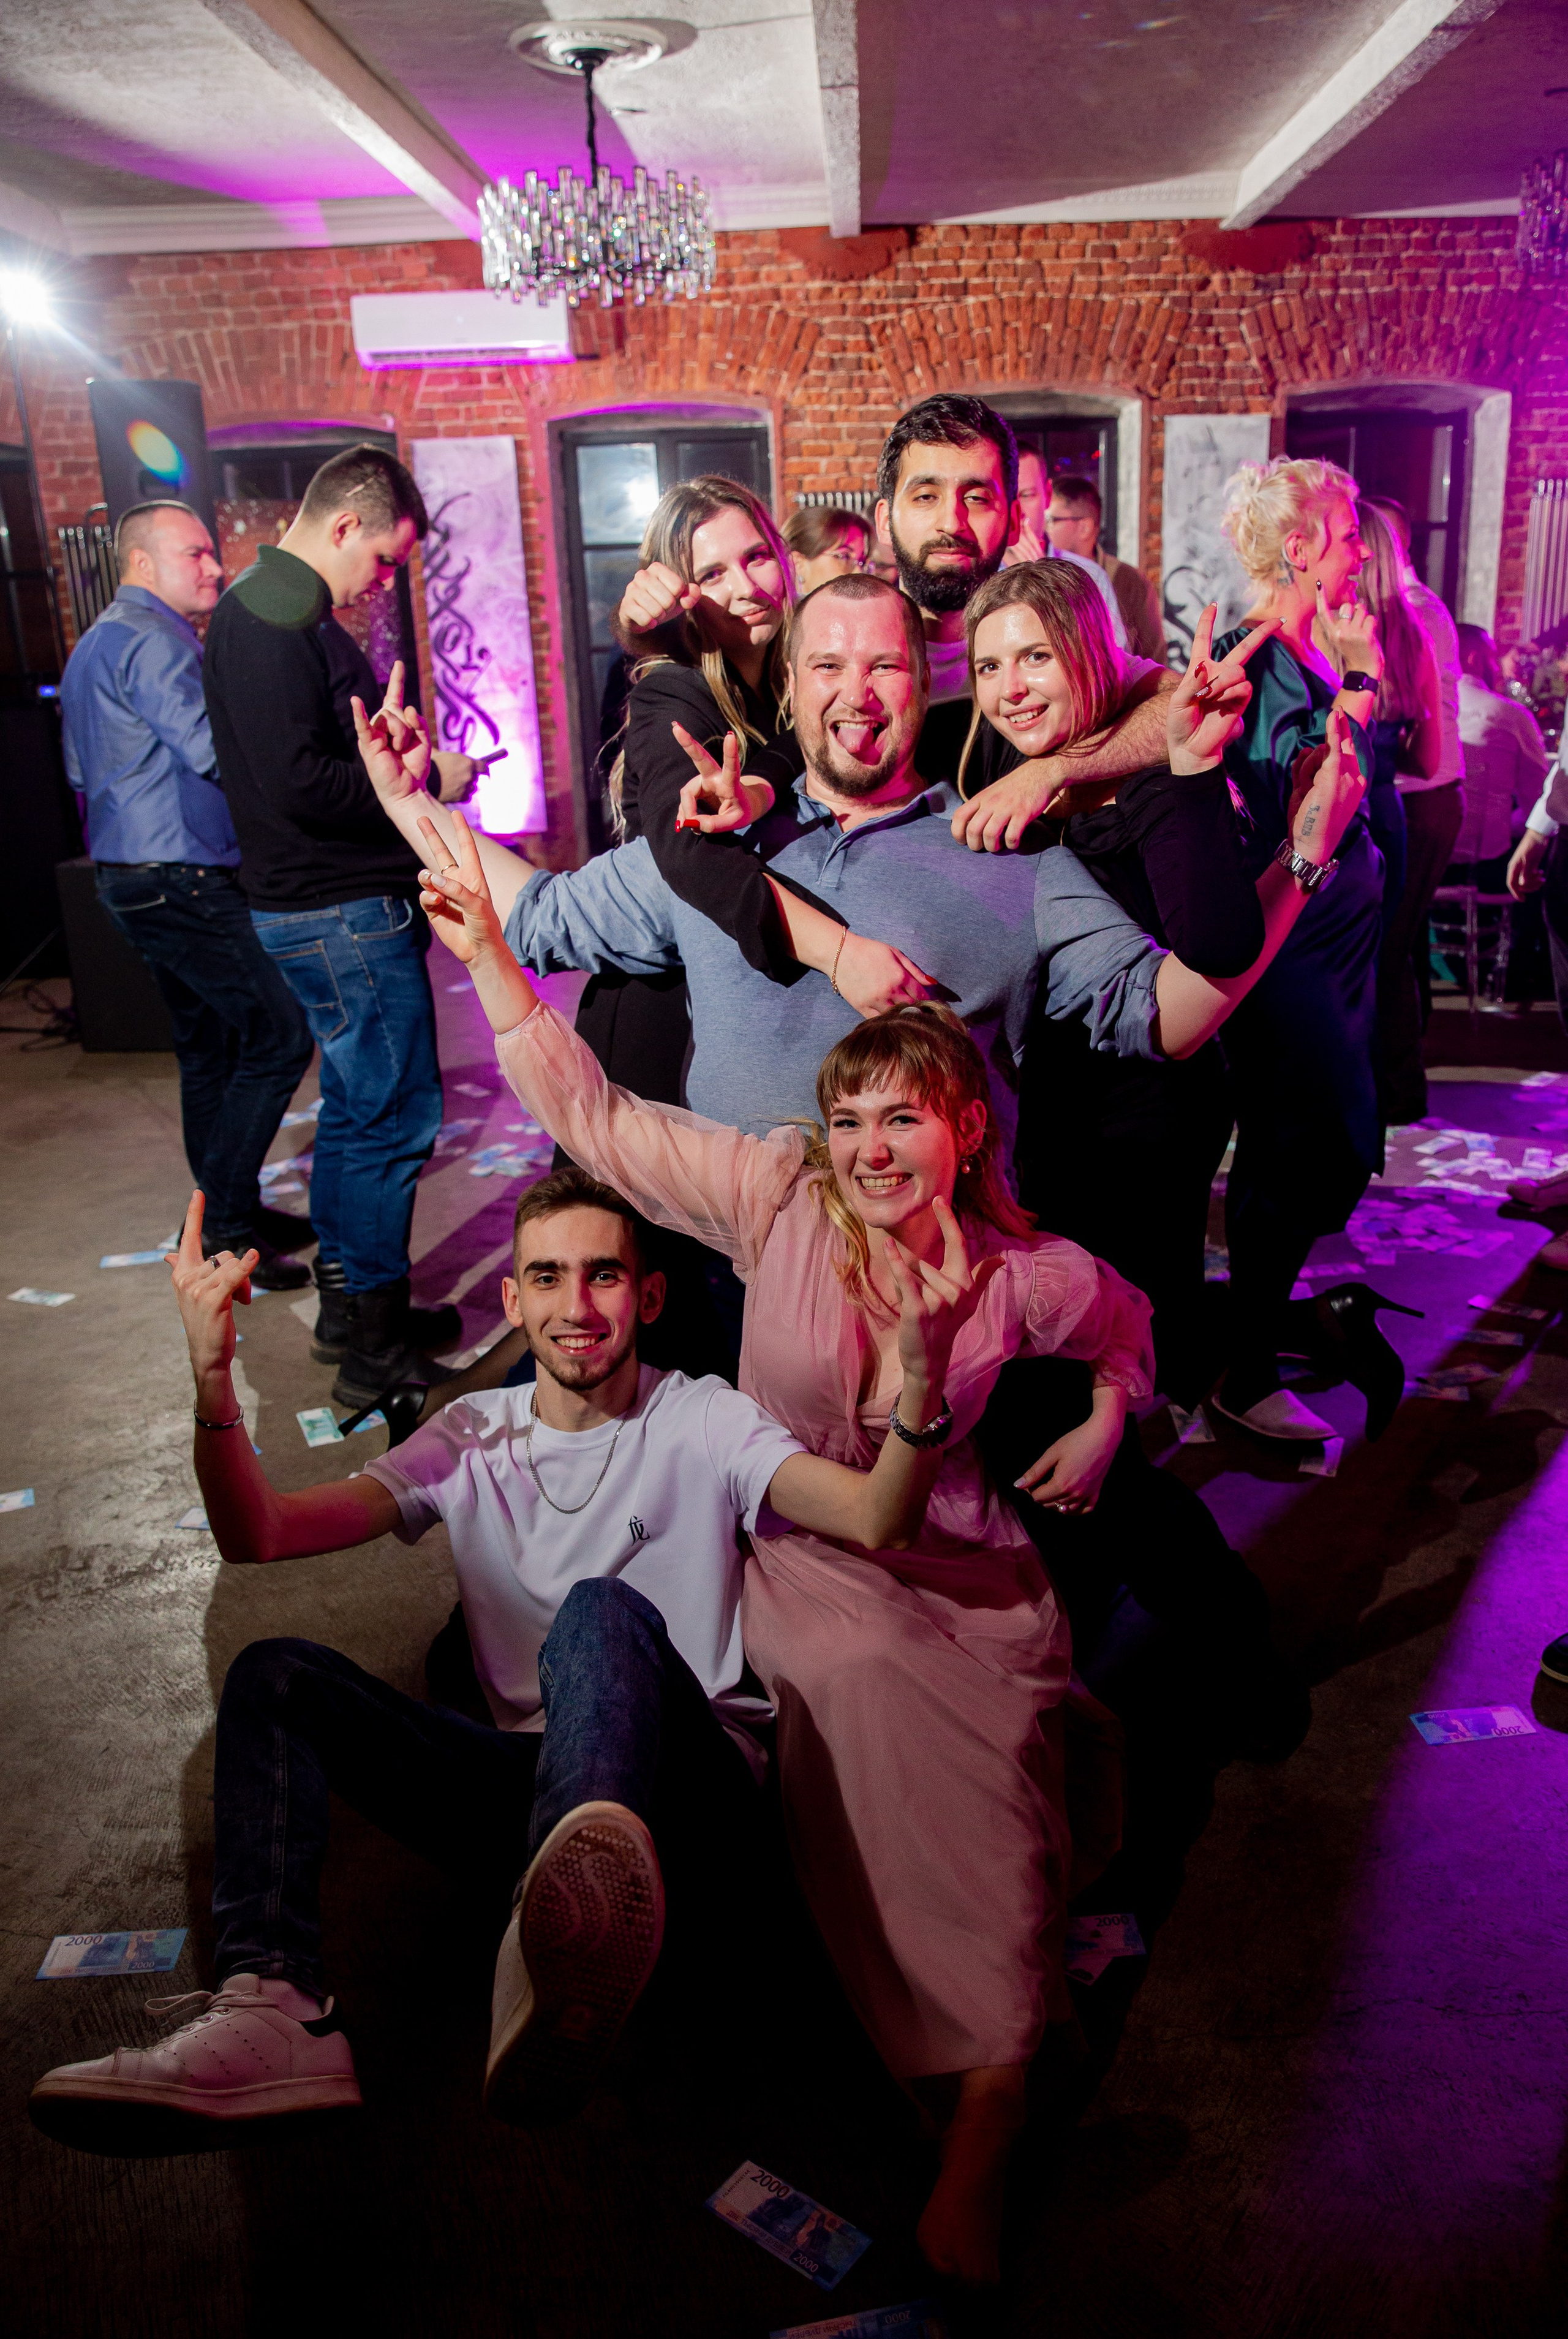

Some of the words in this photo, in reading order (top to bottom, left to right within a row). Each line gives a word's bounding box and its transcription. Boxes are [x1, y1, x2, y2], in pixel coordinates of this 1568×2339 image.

[1493, 1725, 1525, 1736] 2000
[1095, 1915, 1129, 1927] 2000
[65, 1935, 103, 1947] 2000
[750, 2169, 790, 2198] 2000
[725, 2210, 741, 2222] ДВЕ
[740, 2218, 767, 2240] ТЫСЯЧИ
[764, 2234, 793, 2256] ДУБЛЕЙ
[793, 2252, 819, 2273] 2000
[884, 2310, 911, 2324] 2000
